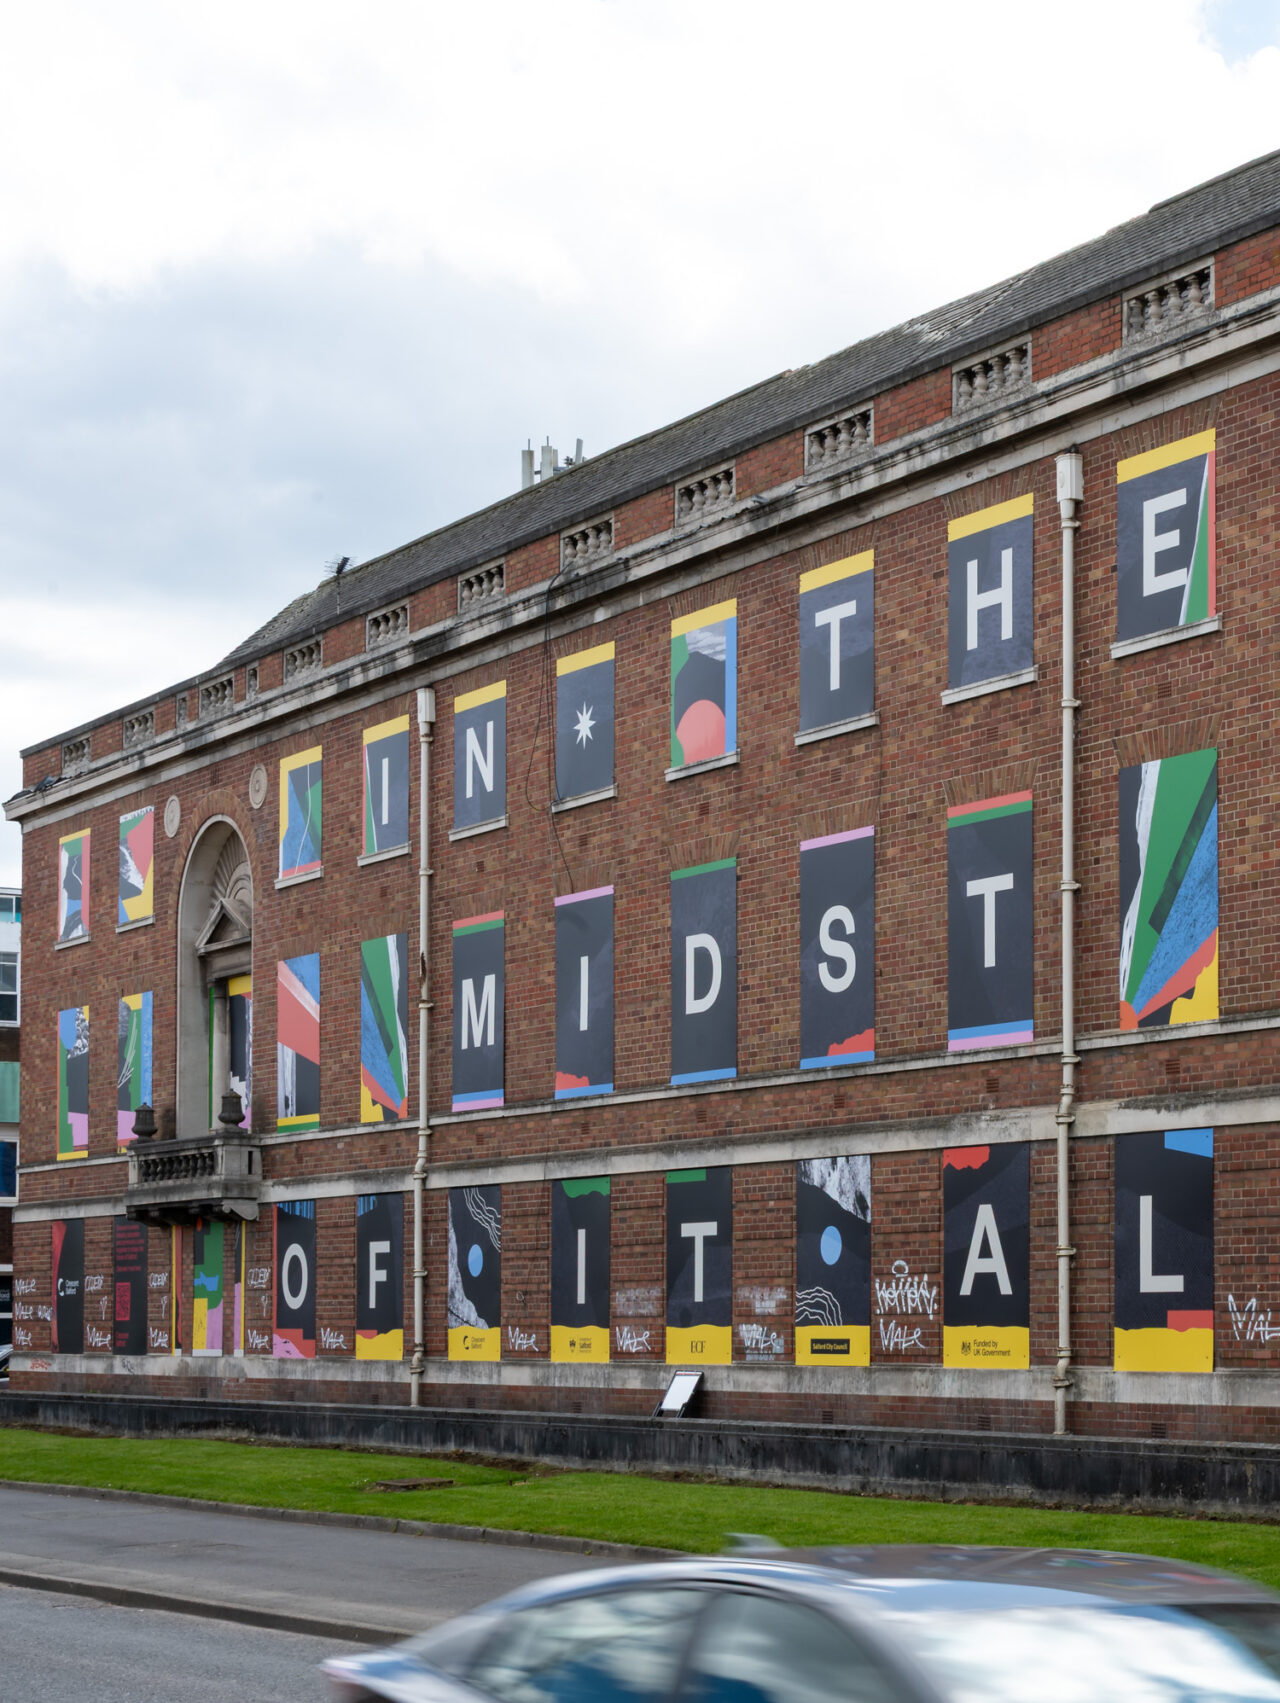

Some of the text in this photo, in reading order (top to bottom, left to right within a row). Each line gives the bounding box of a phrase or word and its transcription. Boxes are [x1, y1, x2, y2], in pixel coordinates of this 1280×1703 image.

[974, 1339, 998, 1349] Funded by
[973, 1348, 1011, 1356] UK Government
